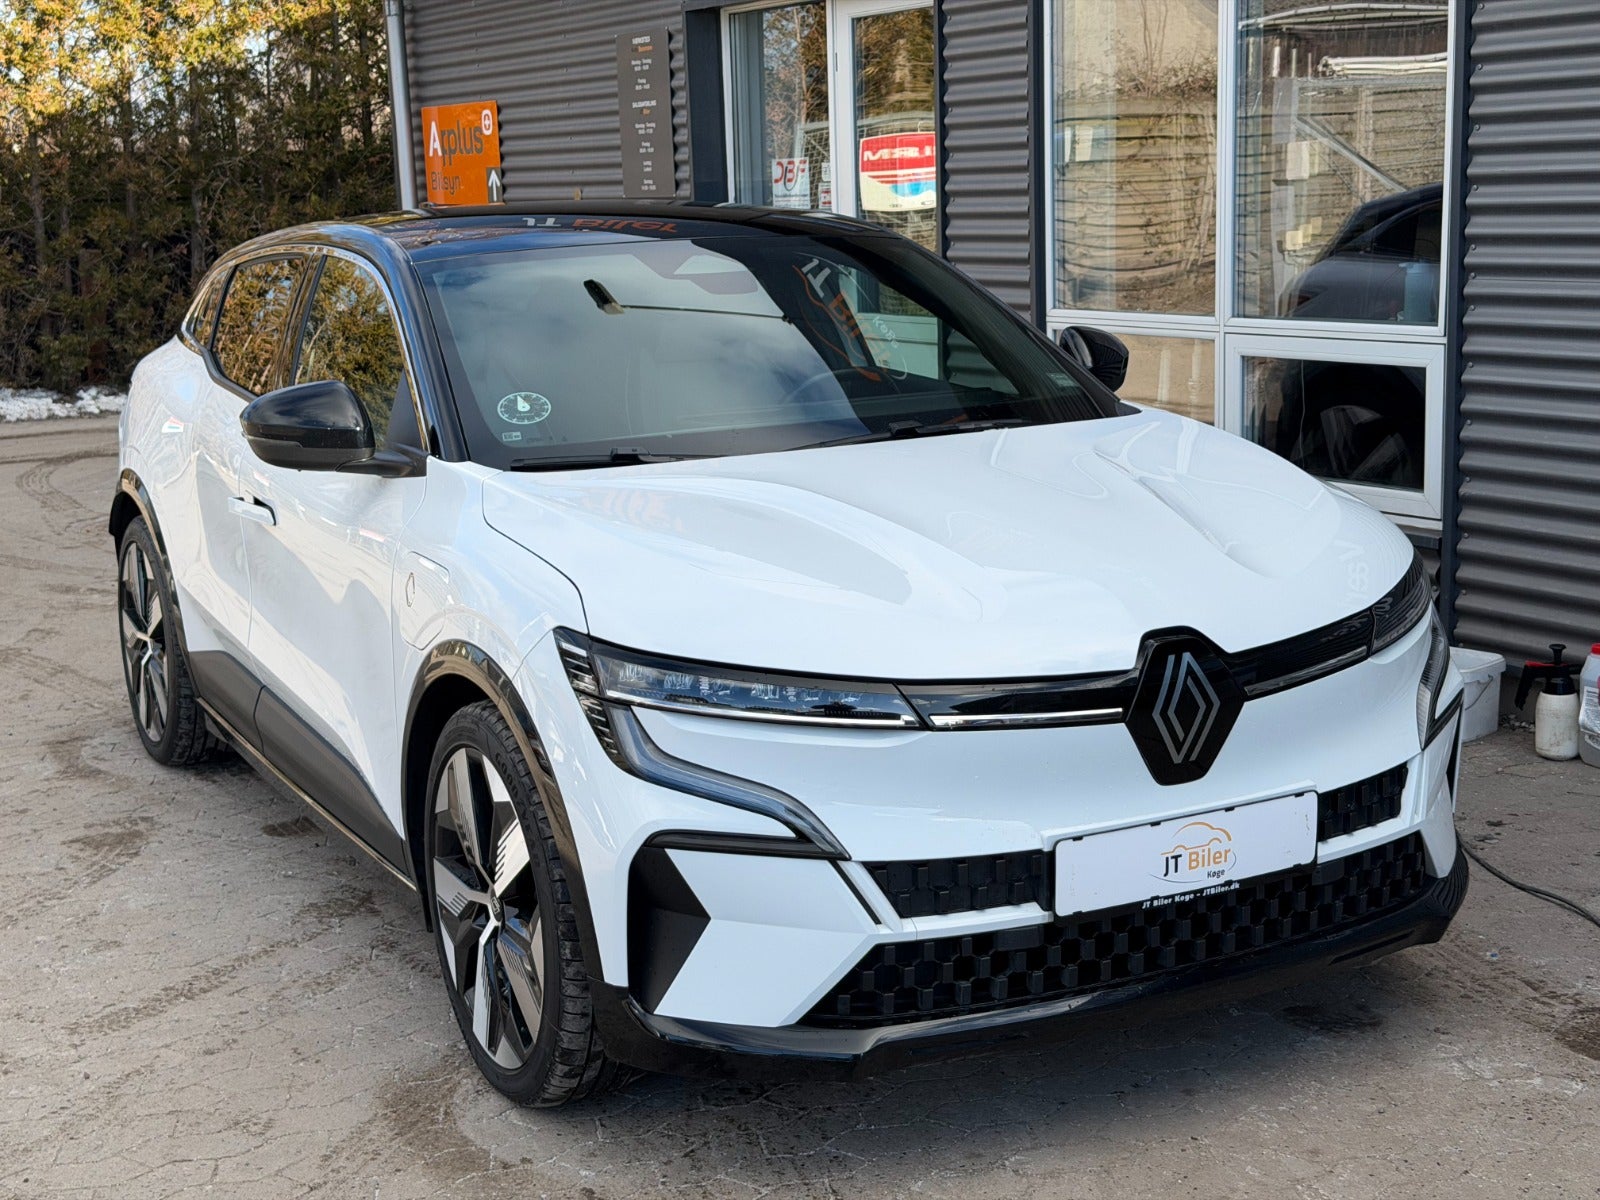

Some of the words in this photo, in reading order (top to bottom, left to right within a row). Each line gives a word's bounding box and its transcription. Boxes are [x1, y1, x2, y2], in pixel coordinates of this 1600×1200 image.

[431, 171, 460, 195] Bilsyn
[1163, 854, 1182, 877] JT
[1188, 847, 1231, 871] Biler
[1207, 869, 1226, 880] Køge
[1141, 900, 1152, 910] JT
[1152, 897, 1173, 907] Biler
[1202, 882, 1240, 896] JTBiler.dk
